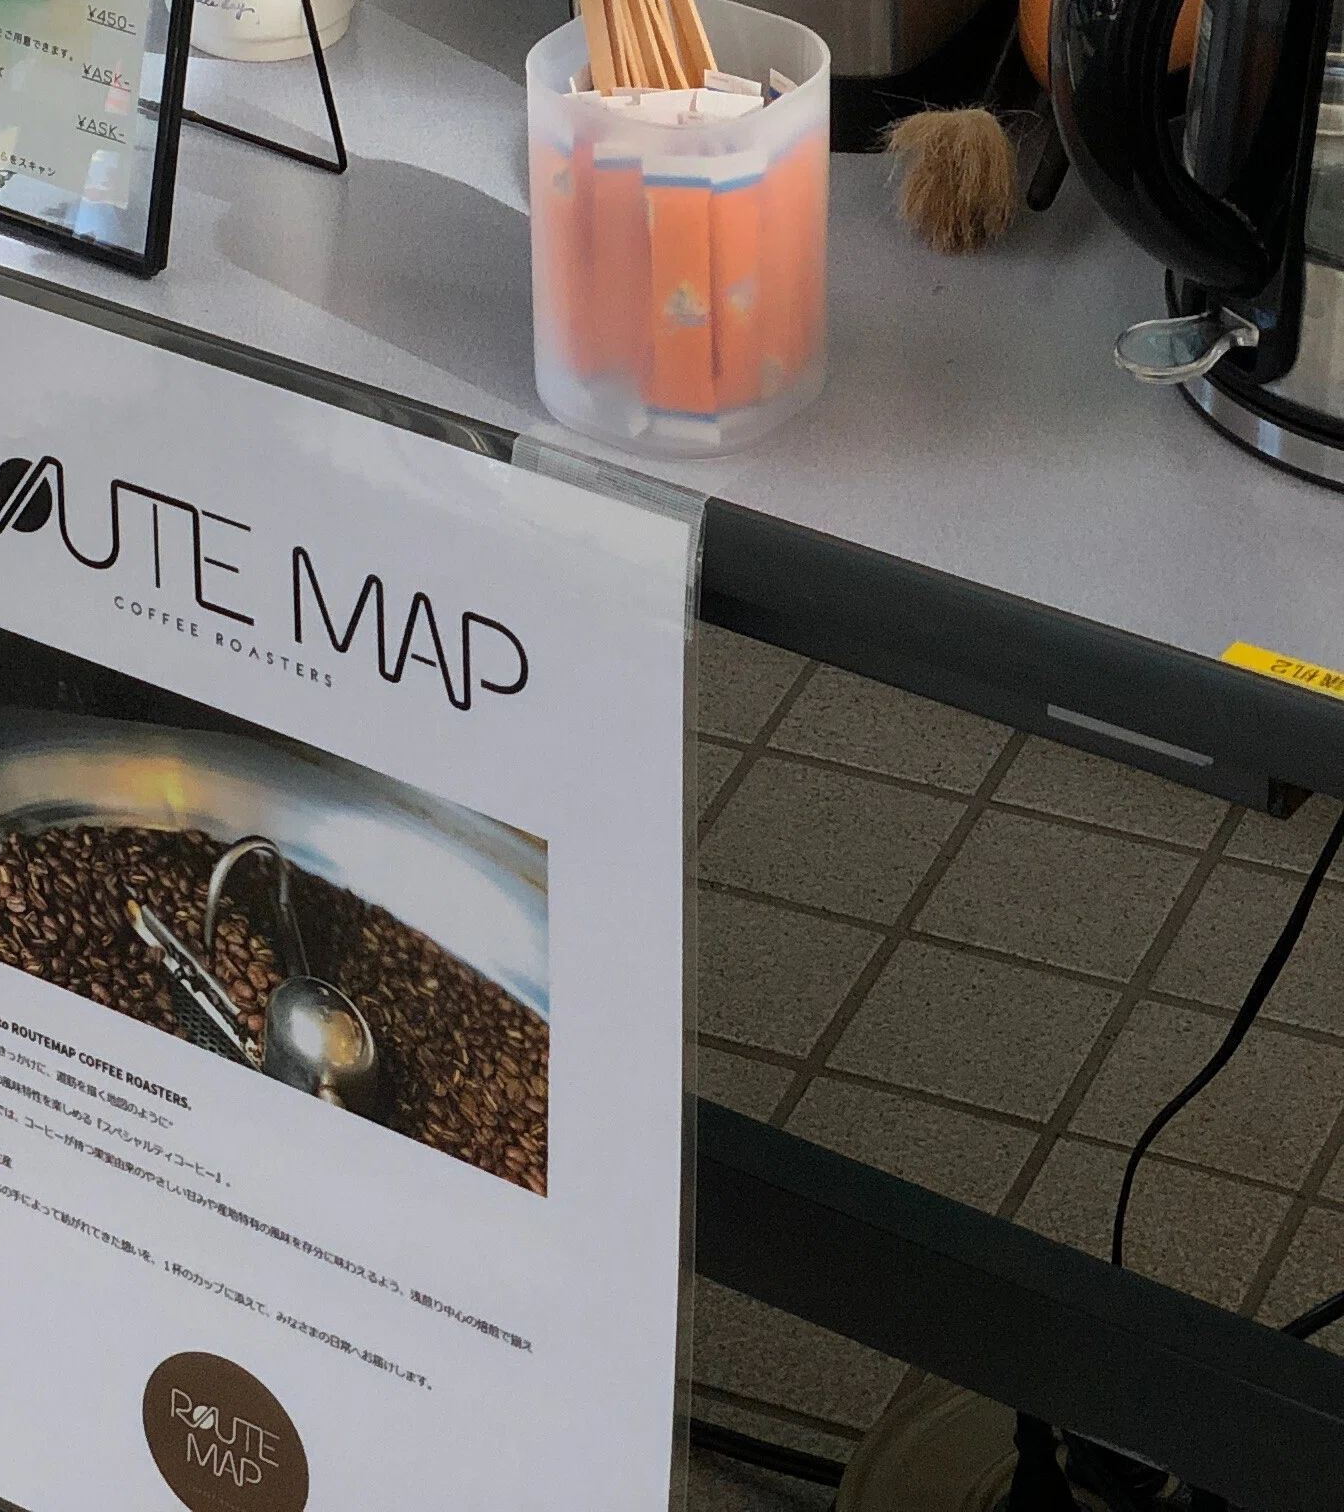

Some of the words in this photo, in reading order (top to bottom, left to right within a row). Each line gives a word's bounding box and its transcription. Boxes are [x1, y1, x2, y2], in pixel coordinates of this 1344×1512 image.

[87, 5, 136, 35] ¥450-
[82, 62, 132, 92] ¥ASK-
[76, 114, 126, 144] ¥ASK-
[113, 594, 201, 639] COFFEE
[215, 632, 334, 689] ROASTERS
[292, 546, 529, 711] MAP
[12, 1022, 76, 1058] ROUTEMAP
[79, 1051, 123, 1079] COFFEE
[126, 1072, 192, 1111] ROASTERS.
[171, 1388, 280, 1468] ROUTE
[187, 1432, 262, 1487] MAP
